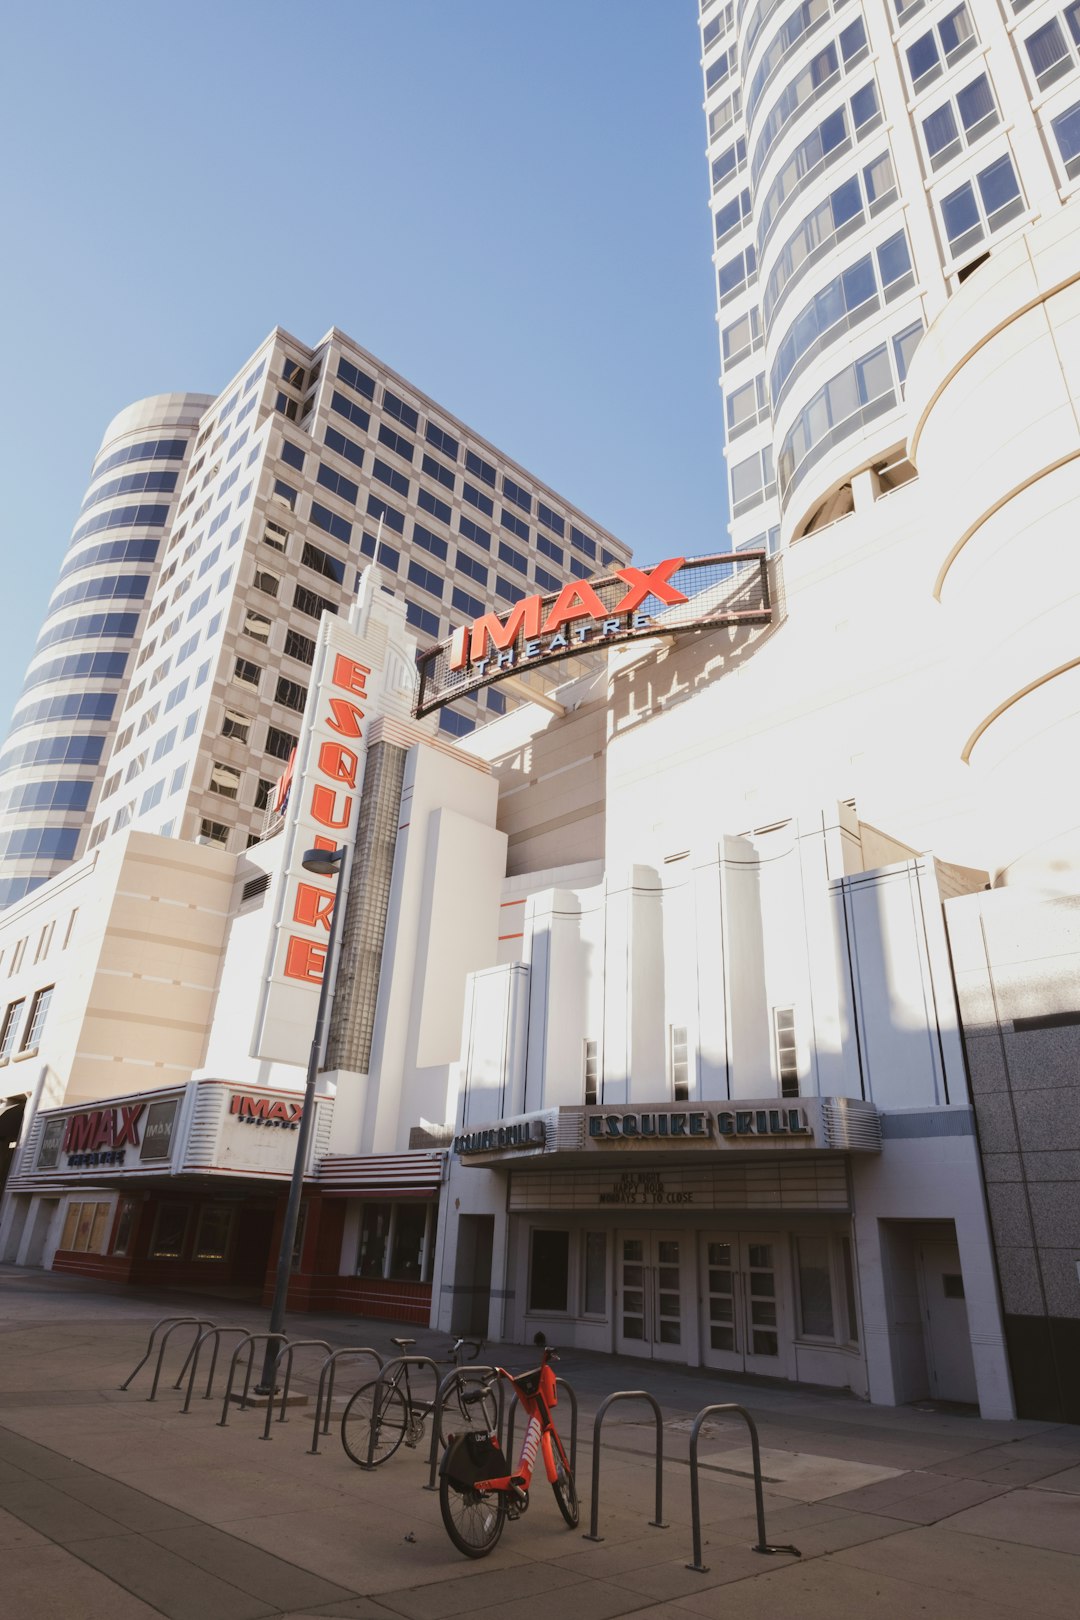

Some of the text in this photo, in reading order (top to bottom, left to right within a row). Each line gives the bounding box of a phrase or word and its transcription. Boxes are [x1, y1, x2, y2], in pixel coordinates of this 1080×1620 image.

[450, 556, 689, 672] IMAX
[476, 614, 653, 677] THEATRE
[230, 1095, 304, 1122] IMAX
[62, 1103, 147, 1153] IMAX
[145, 1122, 173, 1138] IMAX
[238, 1115, 299, 1130] THEATRE
[588, 1109, 811, 1139] ESQUIRE GRILL
[67, 1150, 126, 1167] THEATRE
[613, 1183, 664, 1193] HAPPY HOUR
[641, 1194, 648, 1203] 3
[652, 1193, 663, 1204] TO
[666, 1192, 694, 1203] CLOSE
[474, 1433, 487, 1442] Uber
[521, 1416, 542, 1473] JUMP
